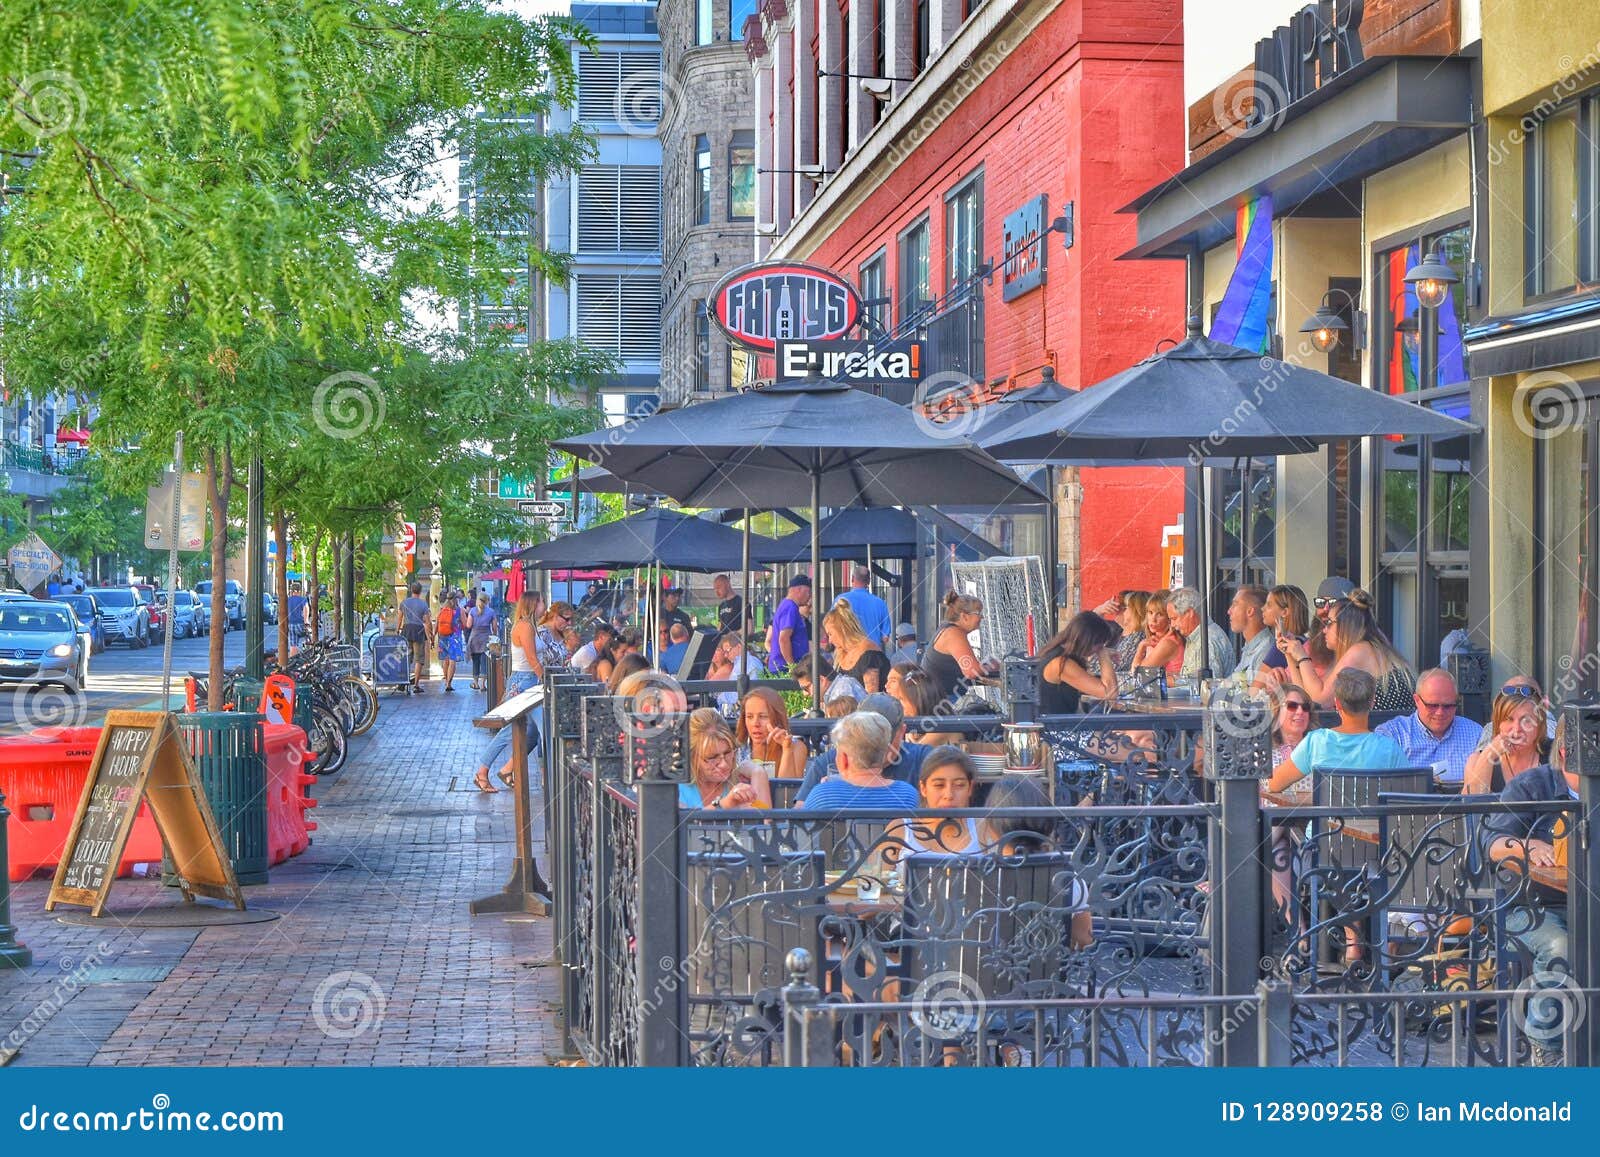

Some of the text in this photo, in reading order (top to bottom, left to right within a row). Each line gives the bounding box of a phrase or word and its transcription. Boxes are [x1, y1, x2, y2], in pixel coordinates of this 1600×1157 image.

[727, 274, 848, 339] FATTYS
[780, 309, 790, 338] BAR
[783, 343, 920, 378] Eureka!
[271, 691, 285, 711] 20
[111, 729, 152, 752] HAPPY
[108, 754, 141, 777] HOUR
